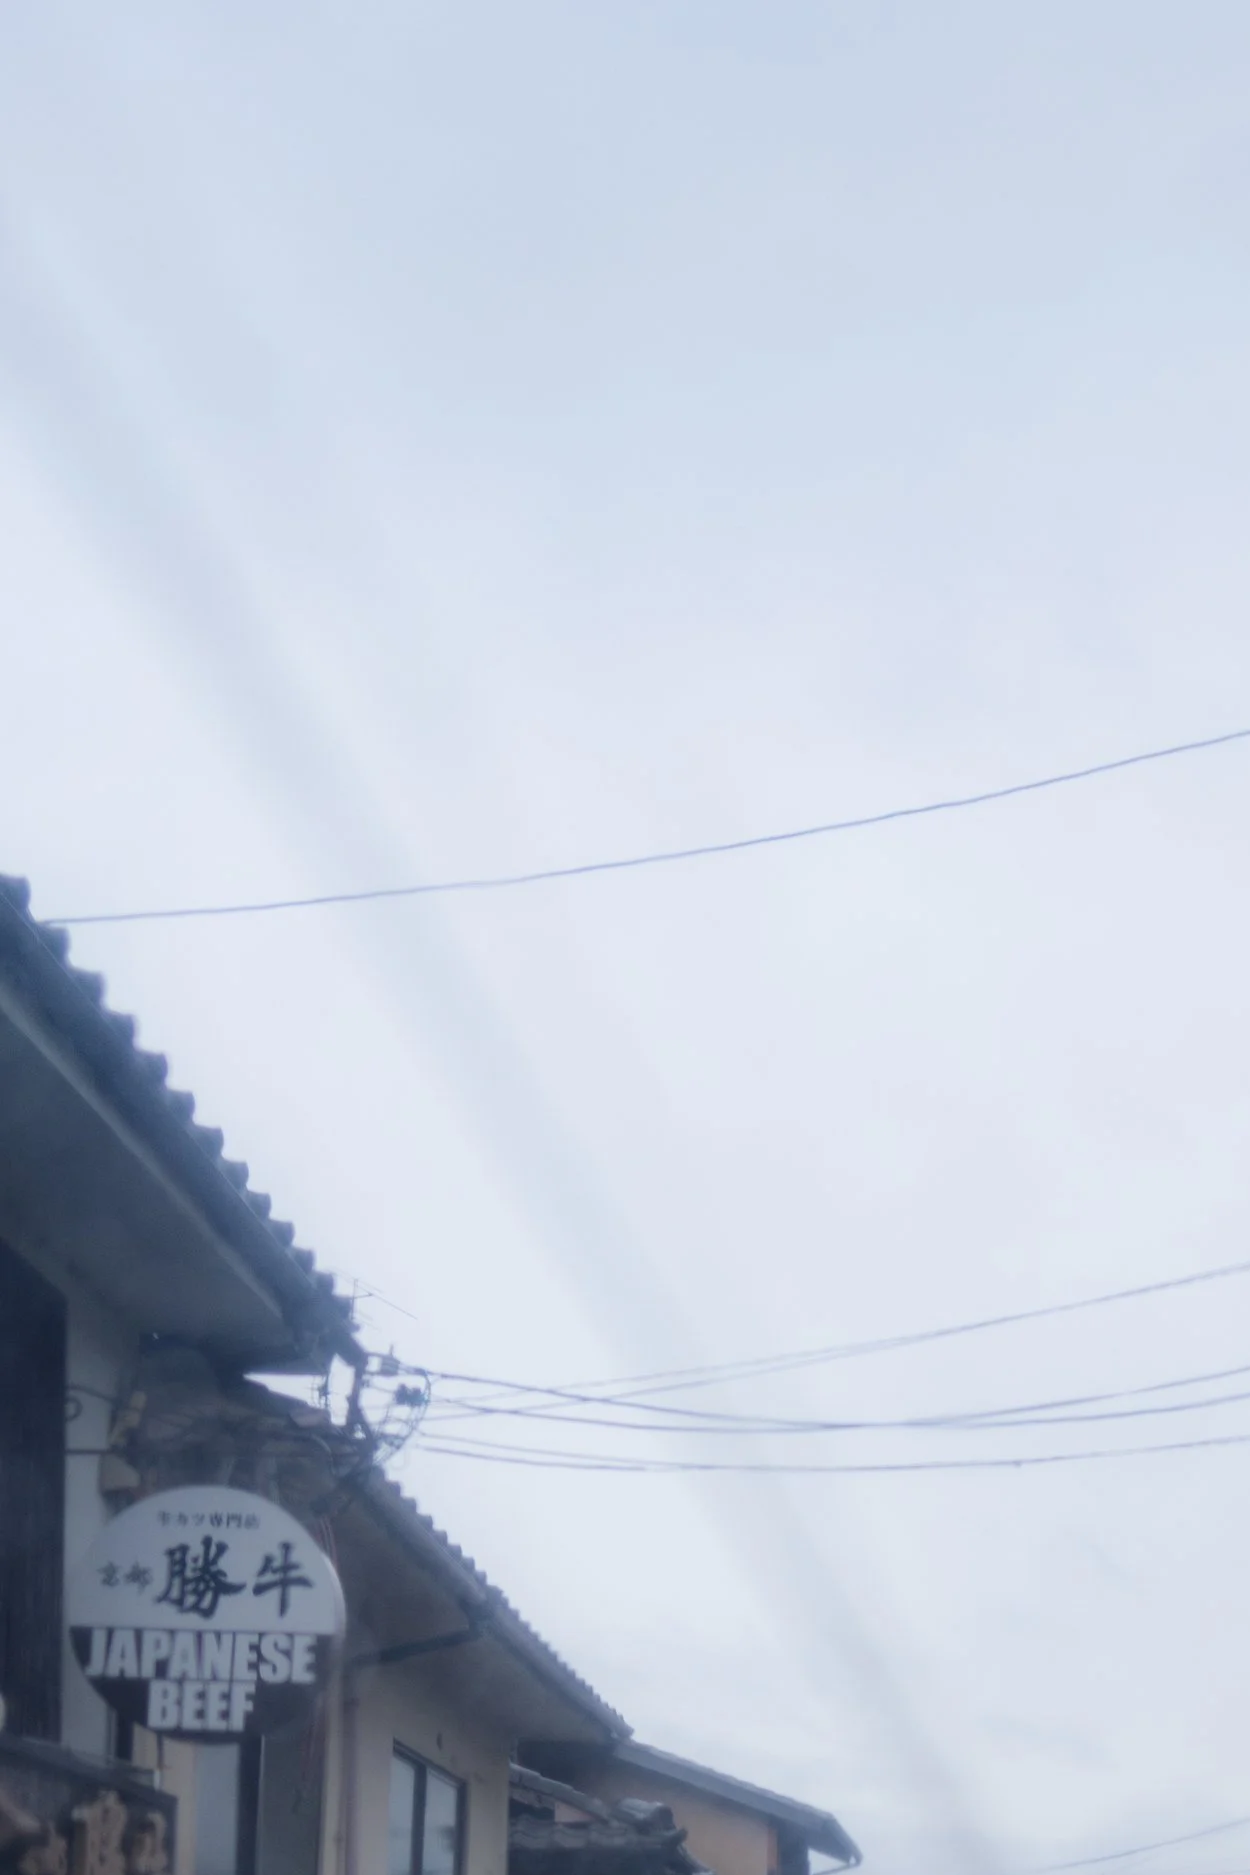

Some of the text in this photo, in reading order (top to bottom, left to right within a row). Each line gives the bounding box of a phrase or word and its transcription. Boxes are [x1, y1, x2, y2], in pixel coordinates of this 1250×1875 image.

[156, 1534, 314, 1620] 勝牛
[85, 1627, 316, 1685] JAPANESE
[147, 1679, 257, 1732] BEEF
